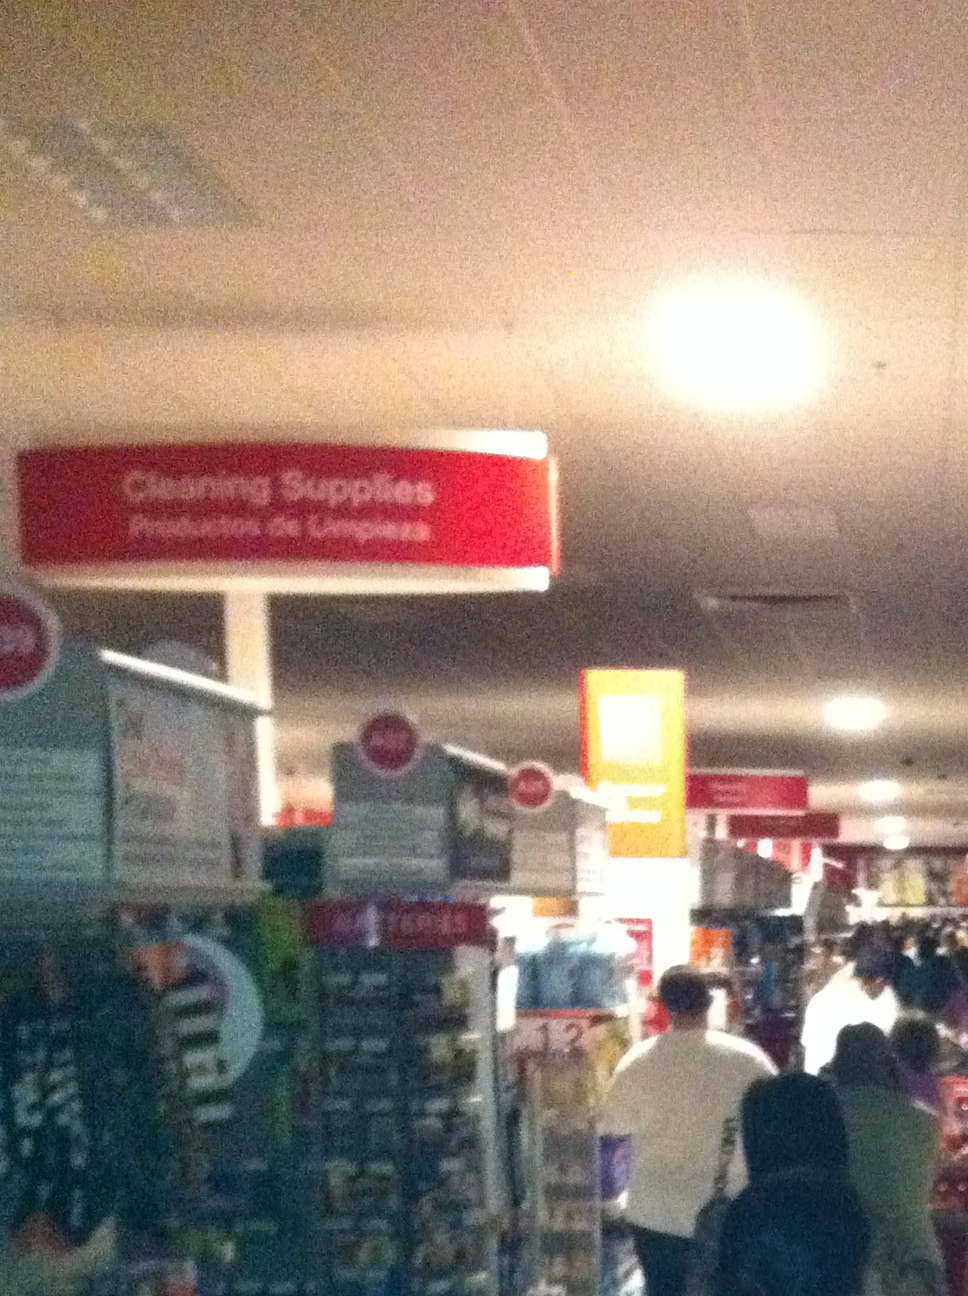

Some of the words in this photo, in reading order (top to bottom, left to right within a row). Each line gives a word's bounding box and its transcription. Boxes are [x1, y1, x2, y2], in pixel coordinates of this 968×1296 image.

[124, 470, 270, 506] Cleaning
[281, 470, 436, 508] Supplies
[128, 515, 262, 538] Productos
[268, 517, 300, 538] de
